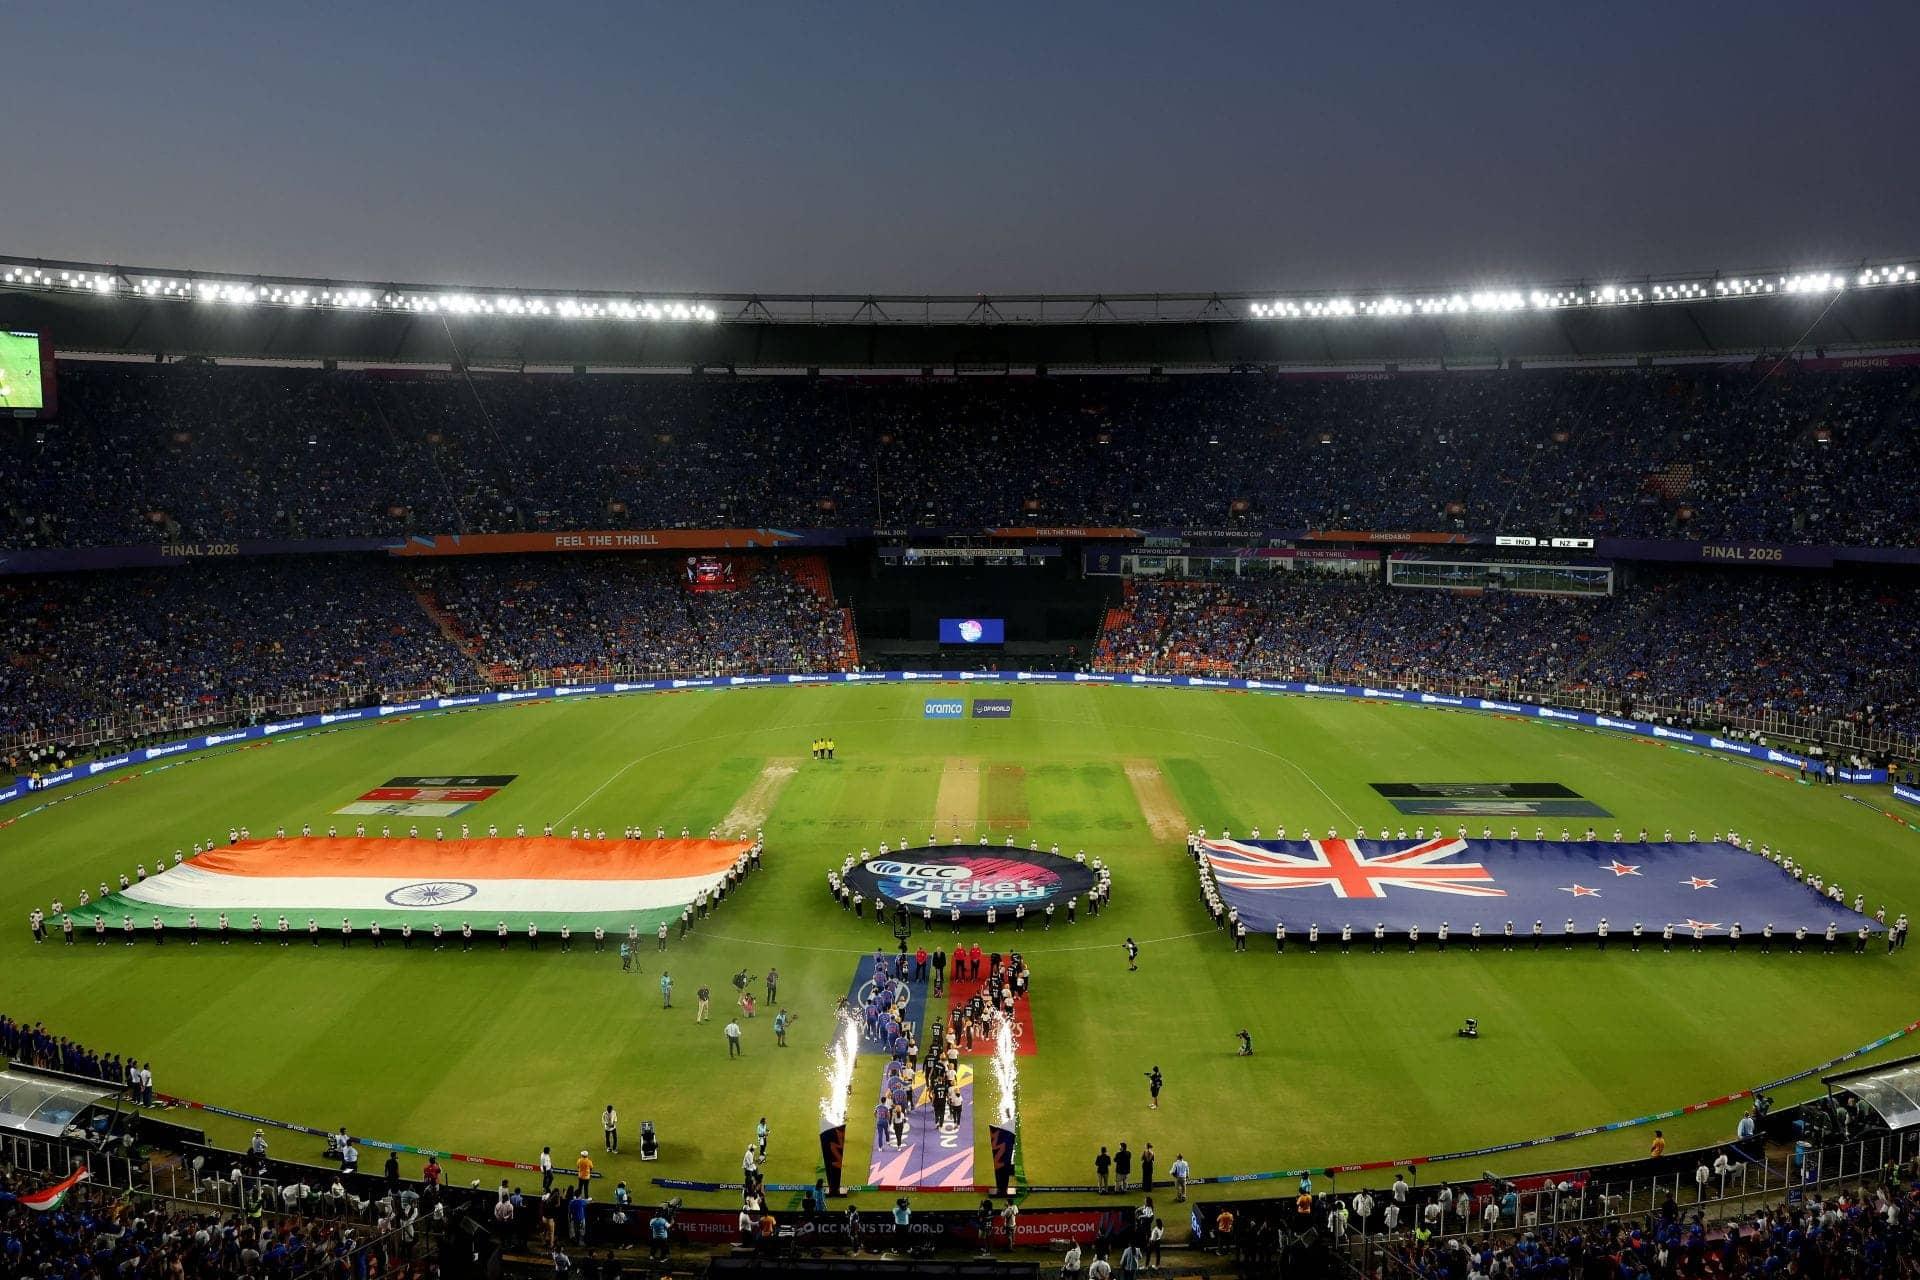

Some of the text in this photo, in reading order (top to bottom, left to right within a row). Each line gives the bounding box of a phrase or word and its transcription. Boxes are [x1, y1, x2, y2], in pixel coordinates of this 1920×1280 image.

[555, 534, 659, 546] FEEL THE THRILL
[161, 544, 239, 556] FINAL 2026
[1702, 546, 1782, 560] FINAL 2026
[925, 704, 962, 714] aramco
[907, 866, 957, 879] ICC
[896, 891, 952, 912] 4
[937, 1090, 945, 1099] 12
[678, 1222, 735, 1233] THE THRILL
[818, 1224, 836, 1233] ICC
[840, 1224, 876, 1233] MN'S
